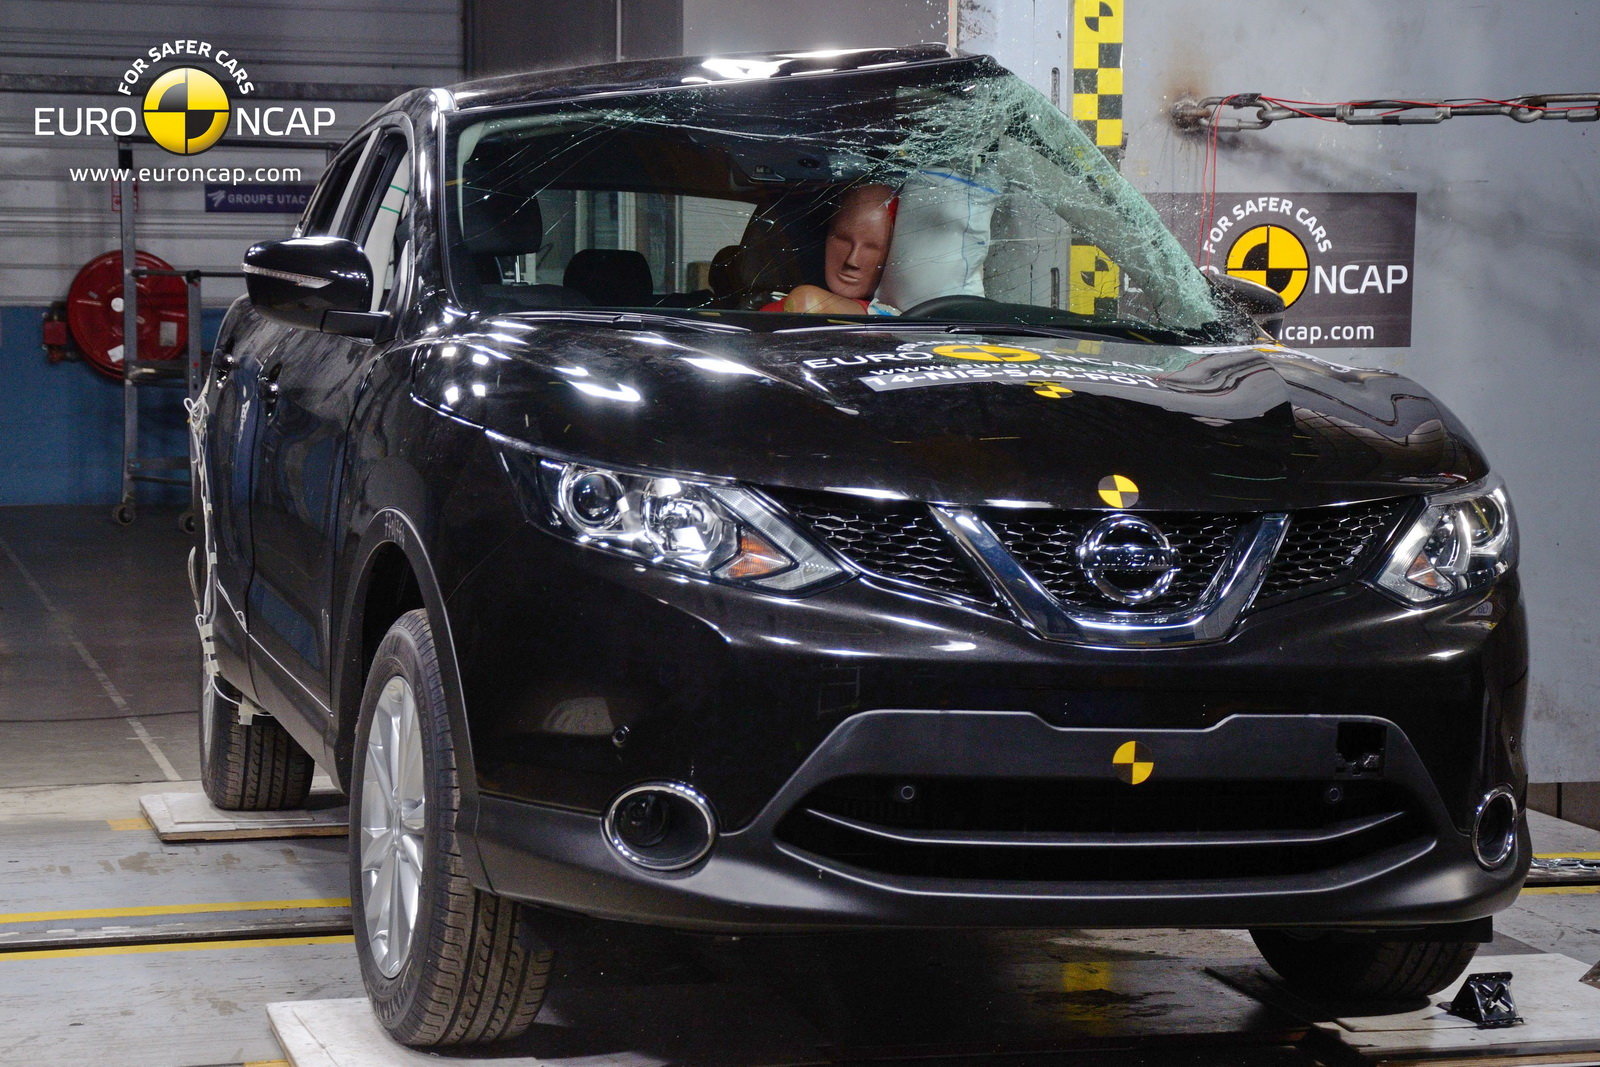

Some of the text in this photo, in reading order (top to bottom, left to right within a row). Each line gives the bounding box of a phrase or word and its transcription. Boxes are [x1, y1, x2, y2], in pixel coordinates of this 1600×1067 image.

[227, 193, 306, 205] GROUPE UTAC
[1203, 197, 1333, 254] FOR SAFER CARS
[1314, 264, 1408, 294] NCAP
[803, 350, 1163, 372] EURO NCAP
[869, 363, 1152, 379] www.euroncap.com
